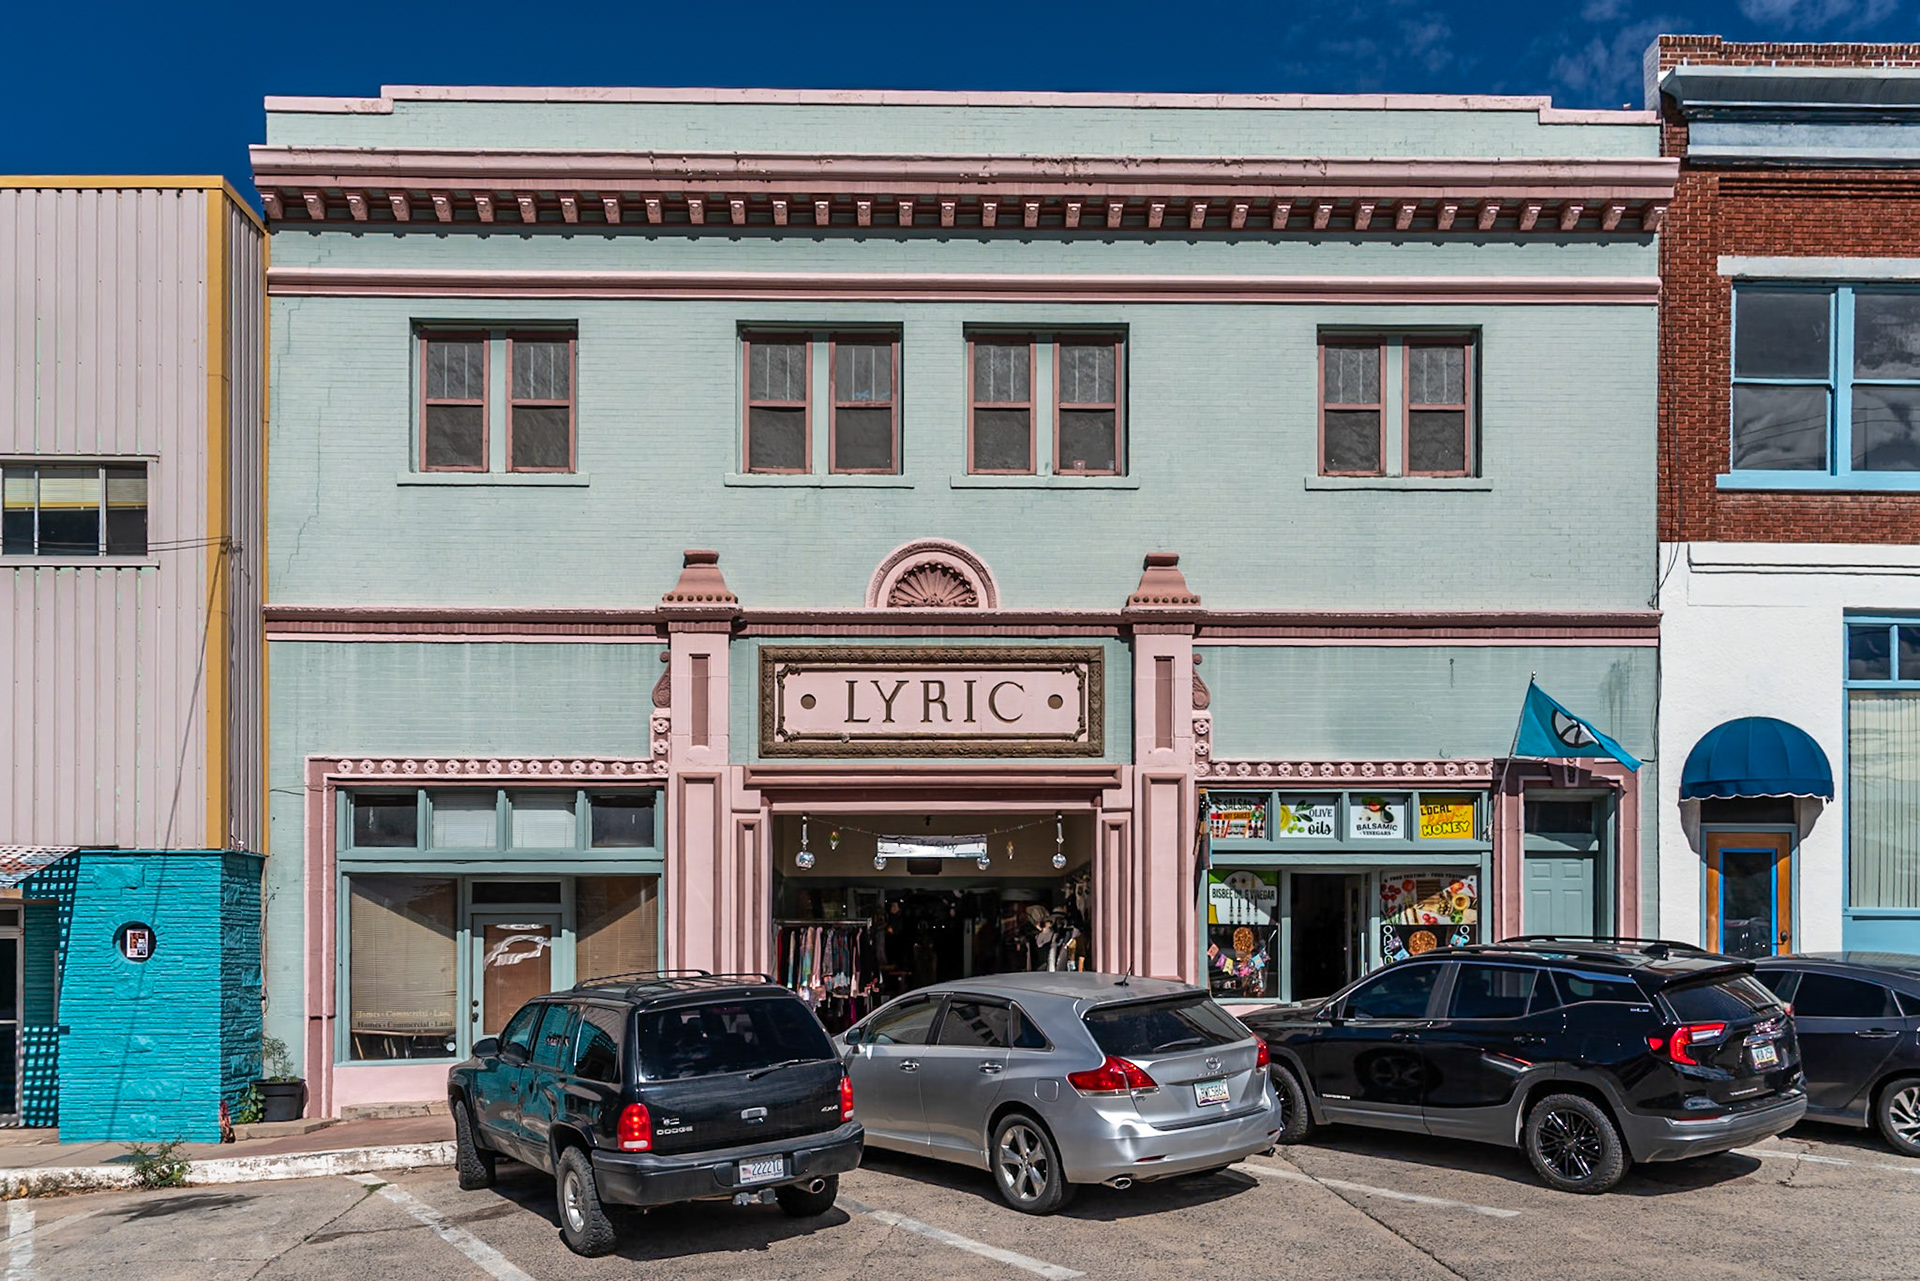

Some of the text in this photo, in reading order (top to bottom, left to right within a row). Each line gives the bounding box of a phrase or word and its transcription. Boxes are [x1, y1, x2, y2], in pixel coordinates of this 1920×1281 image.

[844, 680, 1025, 723] LYRIC
[1223, 798, 1253, 811] SALSAS
[1420, 805, 1452, 816] LOCAL
[1309, 808, 1333, 818] OLIVE
[1308, 821, 1333, 836] oils
[1356, 823, 1399, 832] BALSAMIC
[1422, 820, 1470, 836] HONEY
[1212, 888, 1233, 899] BISBEE
[1250, 889, 1275, 900] VINEGAR
[656, 1126, 693, 1136] DODGE
